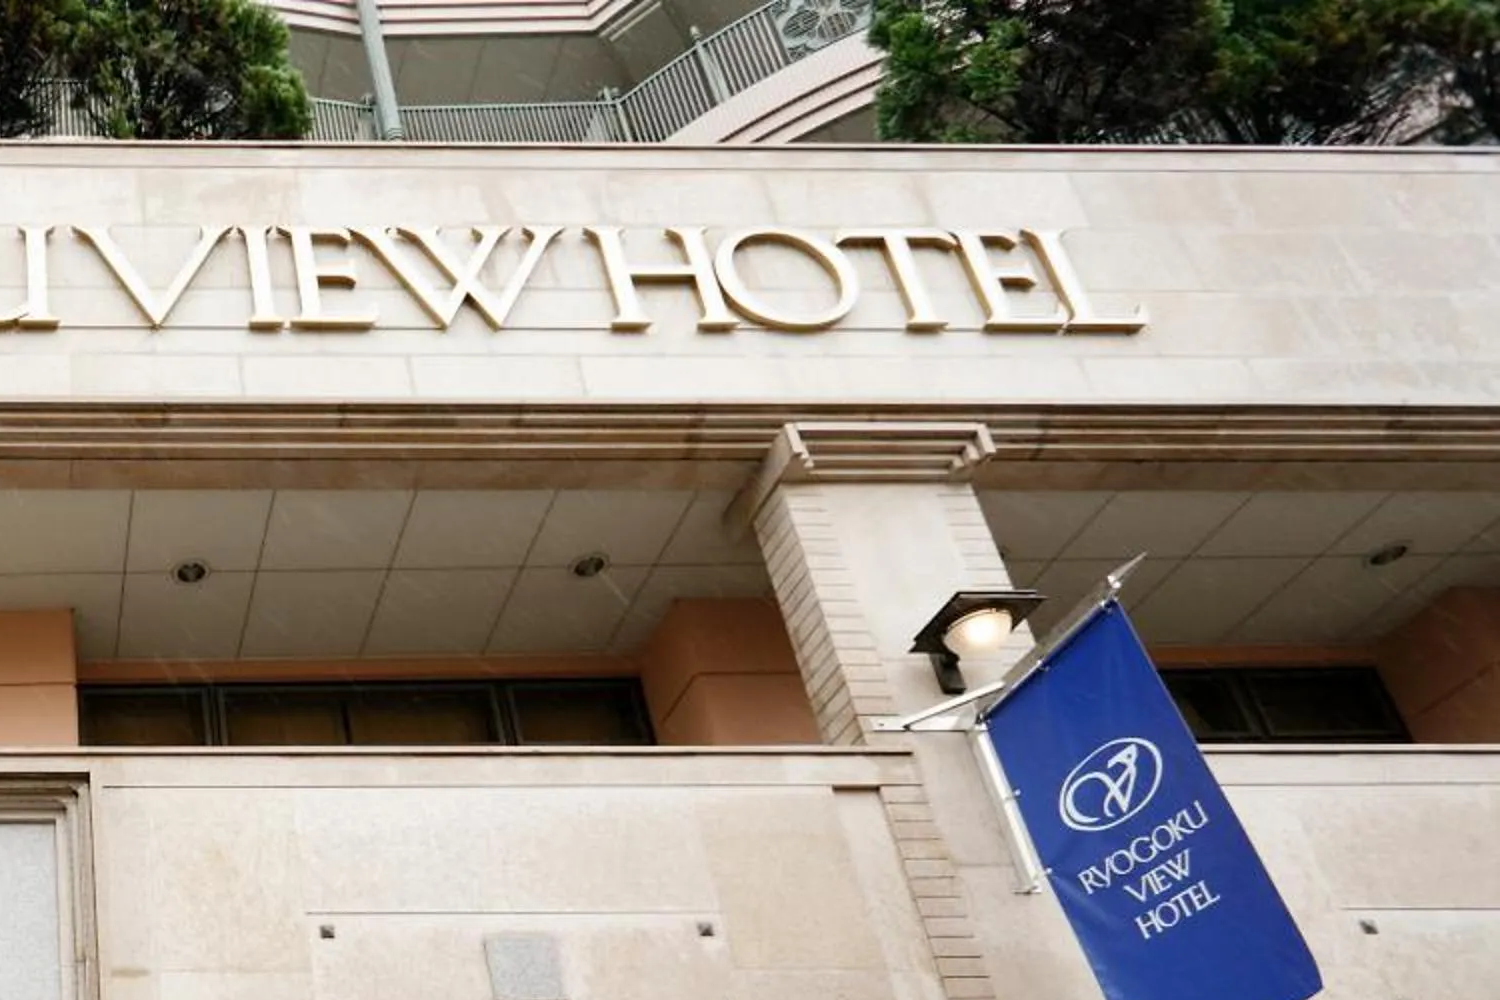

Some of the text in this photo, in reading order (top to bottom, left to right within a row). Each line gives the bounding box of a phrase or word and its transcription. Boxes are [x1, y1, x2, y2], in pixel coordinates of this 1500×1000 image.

[68, 224, 567, 332] VIEW
[583, 226, 1148, 335] HOTEL
[1077, 800, 1209, 895] RYOGOKU
[1123, 848, 1190, 902] VIEW
[1134, 880, 1221, 939] HOTEL
